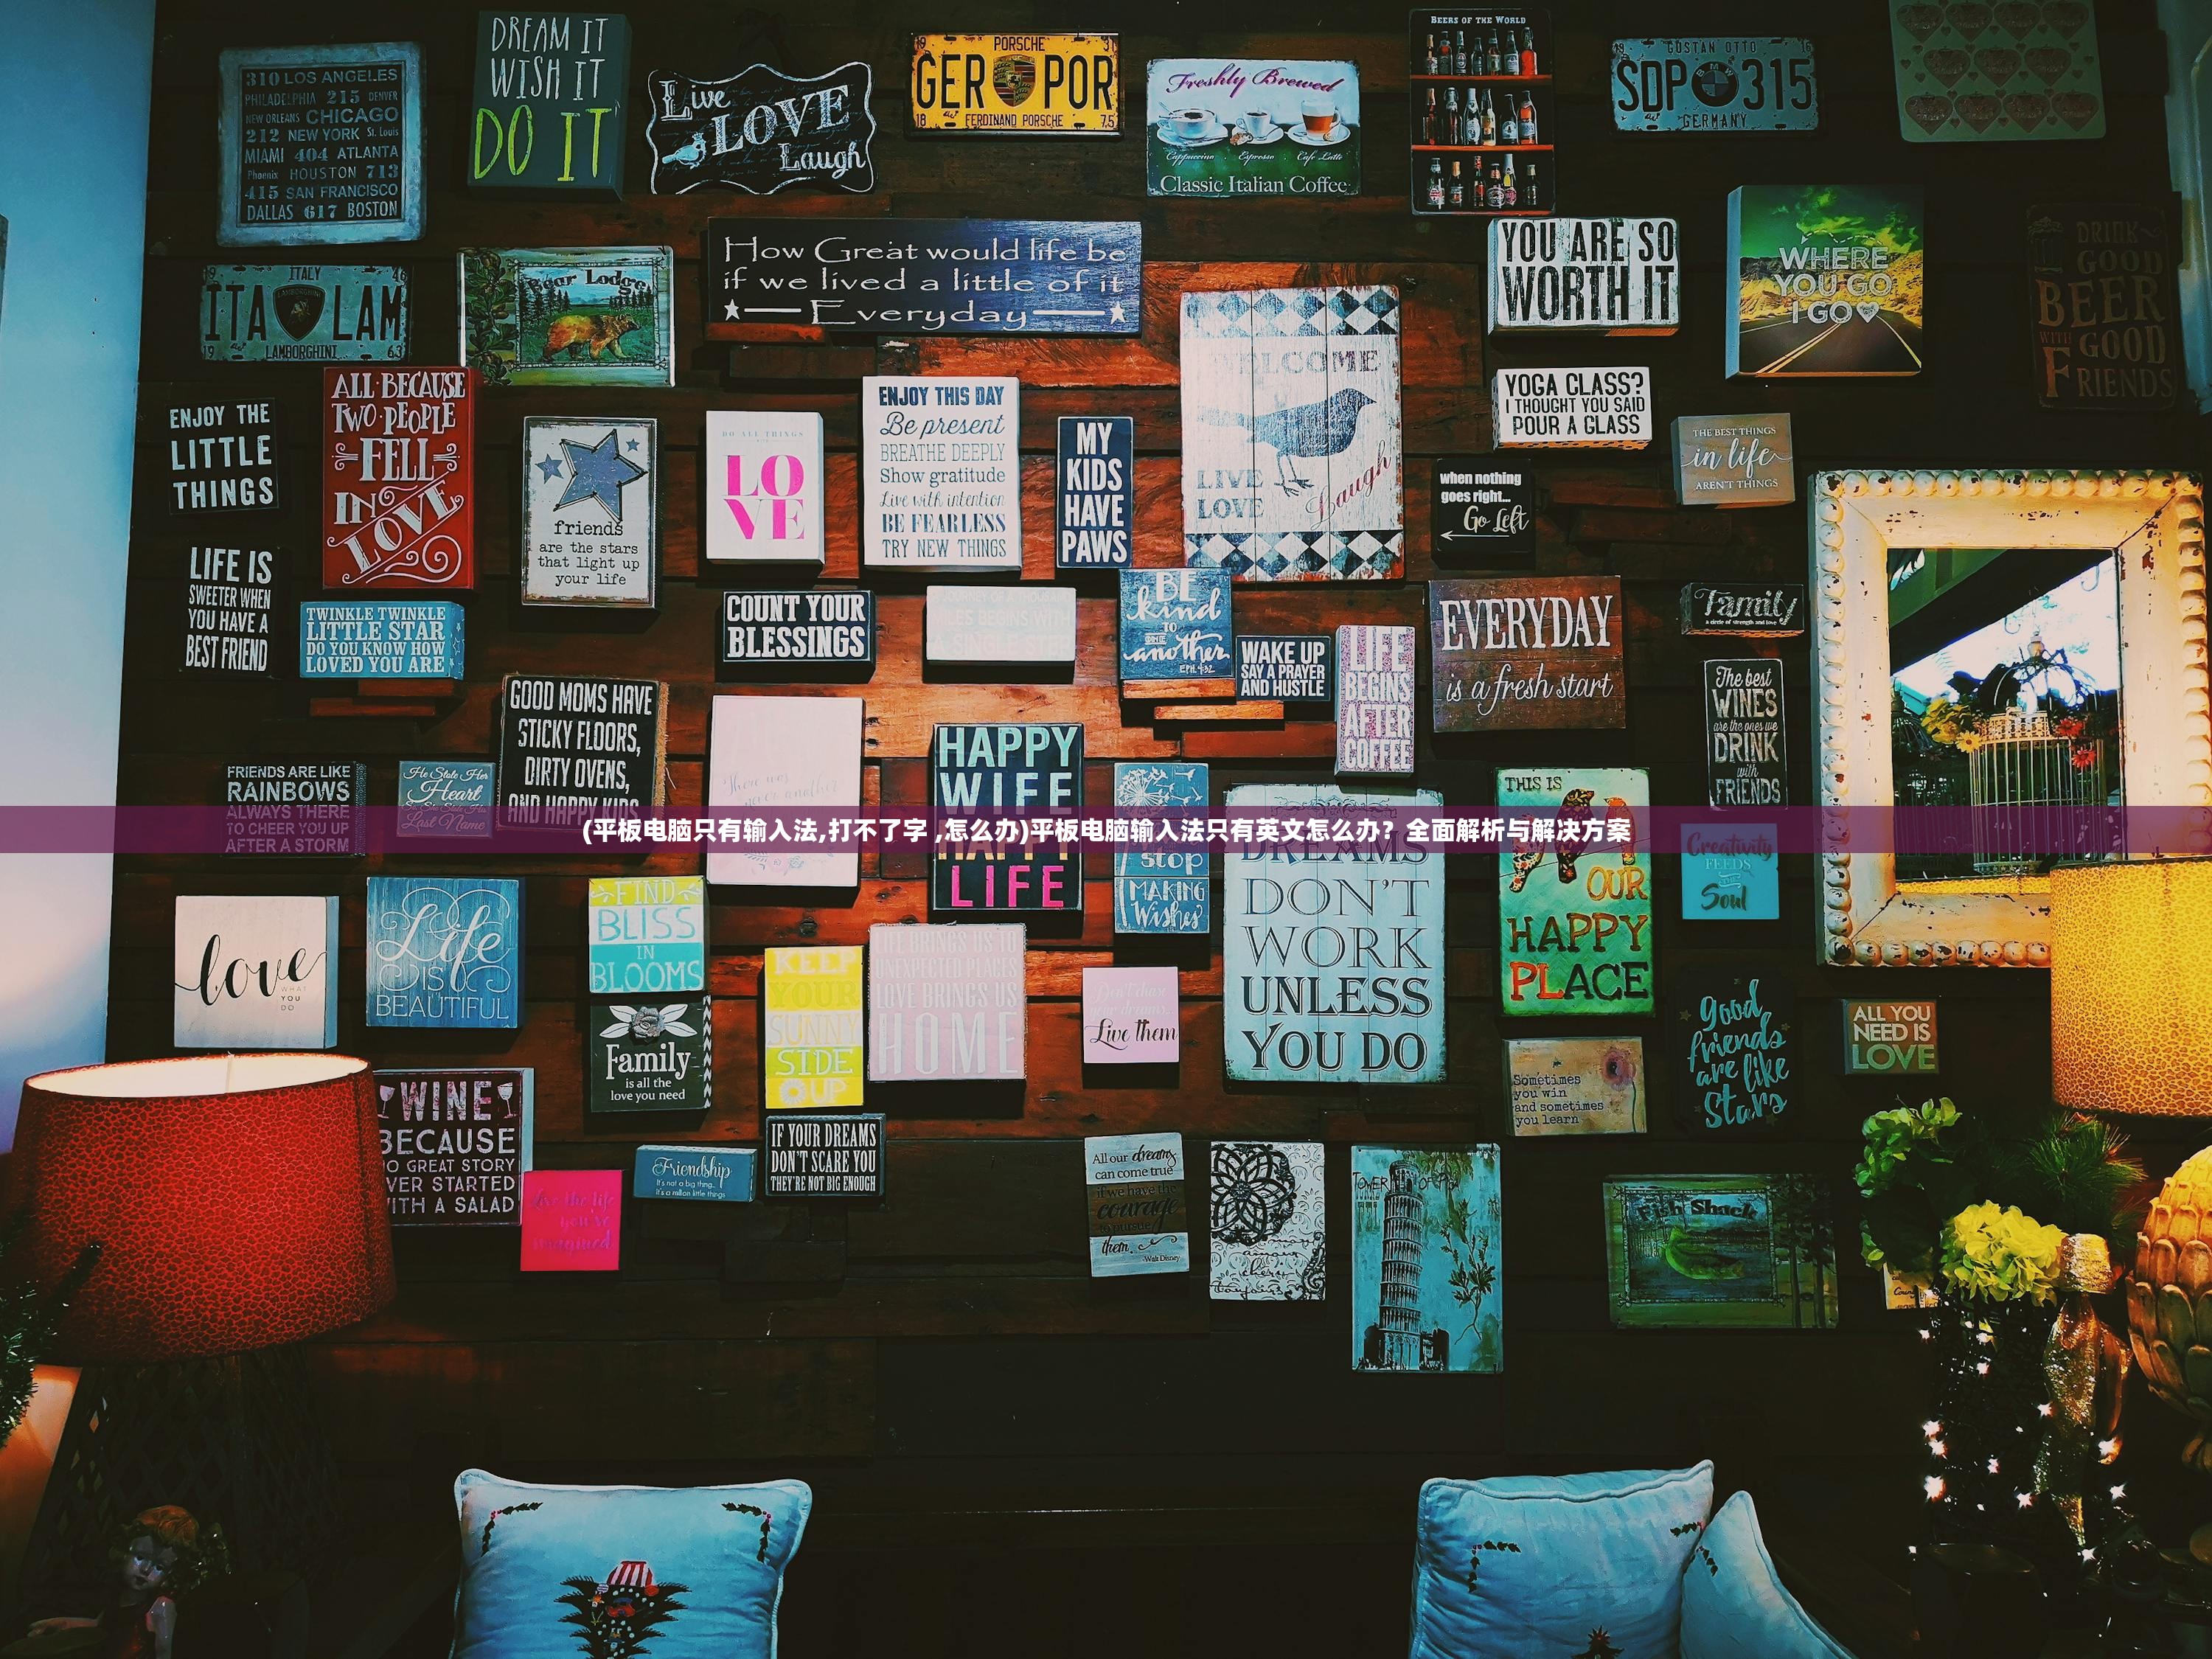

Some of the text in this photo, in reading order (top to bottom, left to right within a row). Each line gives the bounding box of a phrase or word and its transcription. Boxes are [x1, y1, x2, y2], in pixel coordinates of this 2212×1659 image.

[492, 18, 608, 55] DREAM IT
[1725, 41, 1756, 53] OTTO
[246, 69, 398, 87] 310 LOS ANGELES
[917, 55, 1113, 110] GER POR
[1166, 63, 1344, 98] Freshly Brewed
[1617, 58, 1812, 112] SDP 315
[660, 80, 731, 122] Live
[711, 85, 850, 155] LOVE
[965, 114, 1062, 127] FERDINAND PORSCHE
[1683, 114, 1747, 128] GERMANY
[779, 142, 866, 179] Laugh
[1238, 150, 1275, 162] Espresso
[248, 165, 398, 180] Phoenix HOUSTON 713
[1161, 175, 1347, 193] Classic Italian Coffee
[246, 201, 397, 220] DALLAS 617 BOSTON
[724, 236, 1127, 263] How Great would life be
[1502, 221, 1673, 262] YOU ARE SO
[1779, 246, 1888, 270] WHERE
[522, 269, 651, 297] Bear Lodge
[205, 285, 401, 342] ITA LAM
[2039, 275, 2164, 328] BEER
[266, 344, 337, 359] LAMBORGHINI
[879, 386, 1004, 406] ENJOY THIS DAY
[1506, 372, 1644, 397] YOGA CLASS?
[170, 403, 270, 428] ENJOY THE
[1506, 398, 1645, 413] I THOUGHT YOU SAID
[1077, 422, 1113, 455] MY
[1739, 427, 1776, 435] THINGS
[172, 435, 272, 470] LITTLE
[359, 437, 435, 481] FELL
[880, 467, 1005, 487] Show gratitude
[1067, 458, 1122, 491] KIDS
[1197, 469, 1263, 490] LIVE
[1305, 439, 1391, 530] Laugh
[1440, 472, 1521, 487] when nothing
[173, 477, 274, 509] THINGS
[1065, 494, 1124, 528] HAVE
[344, 480, 457, 574] LOVE
[554, 521, 623, 536] friends
[539, 542, 638, 554] are the stars
[1062, 530, 1127, 563] PAWS
[307, 608, 446, 620] TWINKLE TWINKLE
[728, 595, 866, 622] COUNT YOUR
[1694, 589, 1798, 625] Family
[307, 622, 444, 640] LITTLE STAR
[1440, 595, 1613, 651] EVERYDAY
[186, 636, 268, 671] BEST FRIEND
[728, 626, 866, 658] BLESSINGS
[1242, 641, 1325, 664] WAKE UP
[1241, 679, 1324, 697] AND HUSTLE
[1346, 672, 1411, 701] BEGINS
[1447, 663, 1613, 716] is a fresh start
[1716, 666, 1772, 689] The best
[510, 680, 653, 715] GOOD MOMS HAVE
[1712, 689, 1777, 719] WINES
[940, 726, 1077, 768] HAPPY
[1346, 739, 1411, 768] COFFEE
[1714, 732, 1779, 763] DRINK
[227, 765, 350, 779] FRIENDS ARE LIKE
[1506, 776, 1562, 790] THIS IS
[227, 782, 349, 802] RAINBOWS
[407, 779, 482, 802] Heart
[1140, 852, 1203, 868] stop
[951, 866, 1064, 907] LIFE
[1243, 878, 1430, 917] DON'T
[1701, 883, 1747, 911] Soul
[598, 905, 696, 942] BLISS
[1241, 926, 1432, 969] WORK
[174, 934, 327, 1006] love
[592, 961, 700, 990] BLOOMS
[1510, 960, 1649, 1001] PLACE
[376, 995, 509, 1019] BEAUTIFUL
[1701, 978, 1763, 1032] good
[1854, 1005, 1930, 1023] ALL YOU
[878, 1012, 1020, 1075] HOME
[1085, 1019, 1177, 1049] Live them
[1241, 1022, 1427, 1072] YOU DO
[606, 1043, 692, 1080] Family
[776, 1050, 854, 1075] SIDE
[1852, 1044, 1935, 1071] LOVE
[626, 1078, 671, 1088] is all the
[1513, 1074, 1581, 1087] Sometimes
[1514, 1088, 1567, 1100] you win
[400, 1081, 491, 1121] WINE
[771, 1124, 876, 1147] IF YOUR DREAMS
[1093, 1145, 1176, 1166] All our dreams
[653, 1156, 732, 1188] Friendship
[387, 1196, 514, 1214] ITH A SALAD
[1636, 1200, 1758, 1222] Fish Shack
